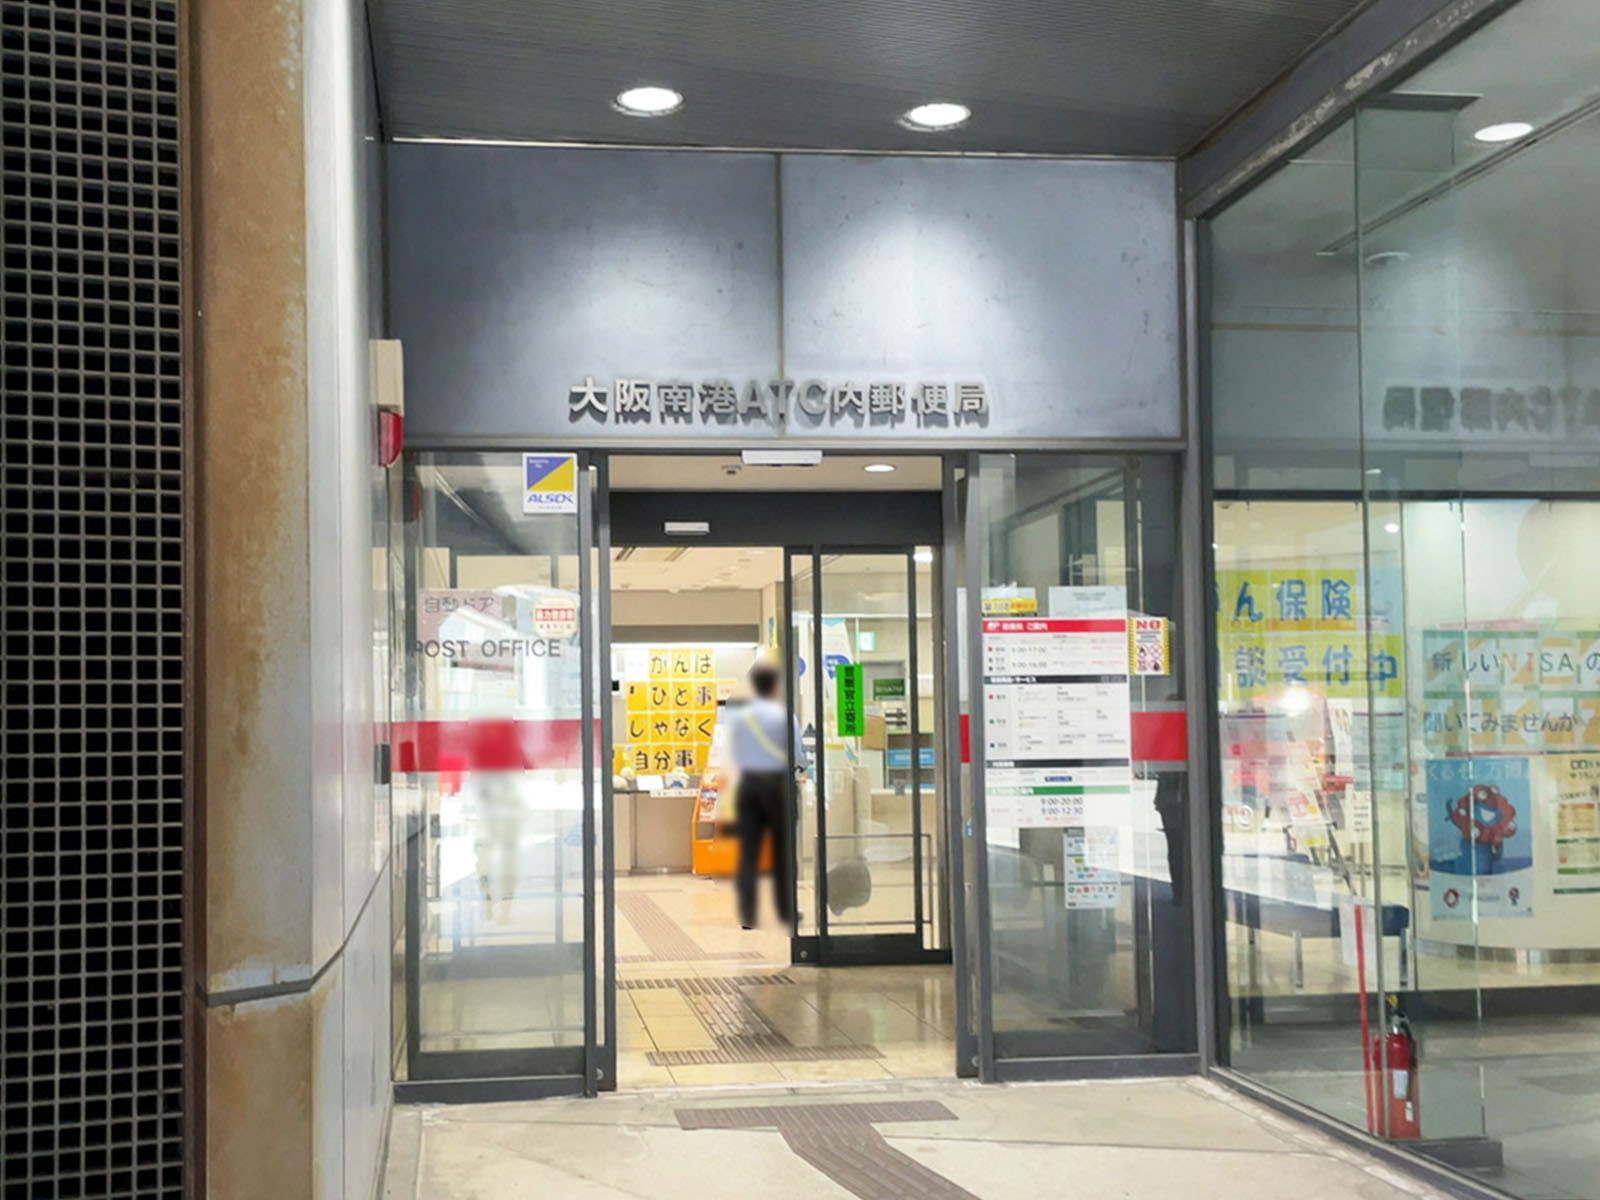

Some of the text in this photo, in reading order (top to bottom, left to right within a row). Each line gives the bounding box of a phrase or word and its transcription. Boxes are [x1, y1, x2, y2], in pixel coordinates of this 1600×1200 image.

[569, 376, 990, 420] 大阪南港ATC内郵便局
[528, 493, 574, 504] ALSOK
[1215, 578, 1351, 622] ん保険
[411, 639, 561, 658] POST OFFICE
[1217, 645, 1398, 692] 談受付中
